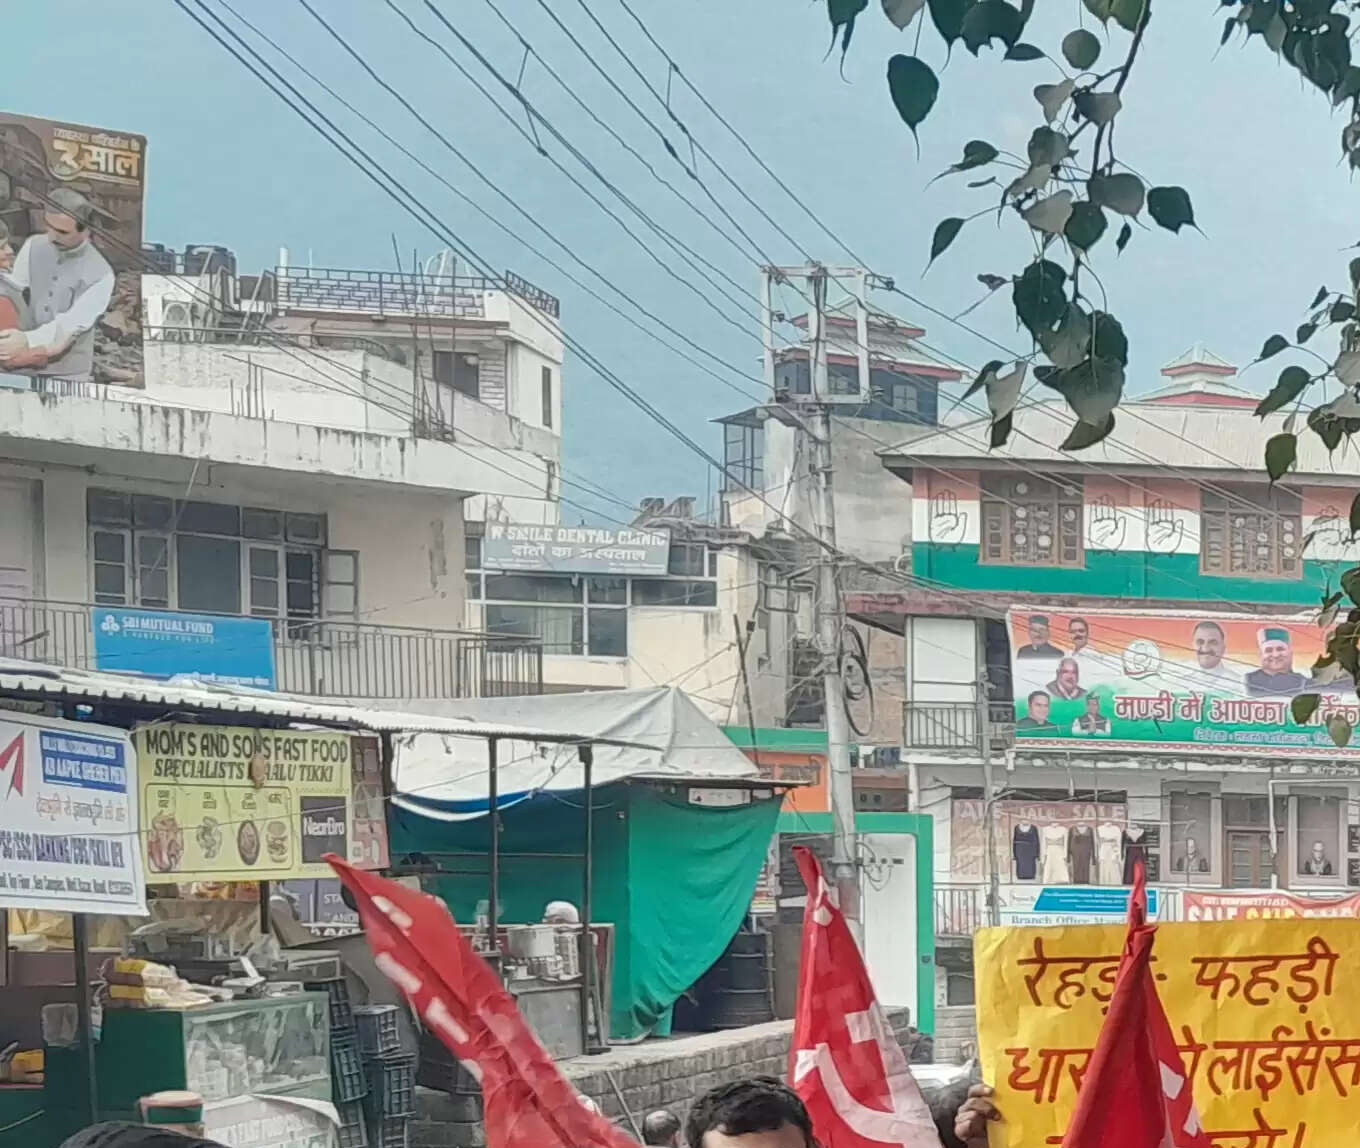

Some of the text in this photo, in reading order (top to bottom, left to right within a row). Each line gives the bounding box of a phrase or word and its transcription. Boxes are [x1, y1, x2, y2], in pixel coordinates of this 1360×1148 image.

[557, 527, 615, 545] DENTAL
[122, 616, 213, 635] SBI MUTUAL FUND
[1115, 689, 1174, 722] मण्डी
[1180, 690, 1205, 721] में
[1209, 700, 1286, 724] आपका
[146, 729, 197, 755] MOM'S
[200, 731, 229, 758] AND
[274, 736, 308, 761] FAST
[312, 738, 348, 763] FOOD
[153, 757, 245, 780] SPECIALISTS
[299, 763, 334, 783] TIKKI
